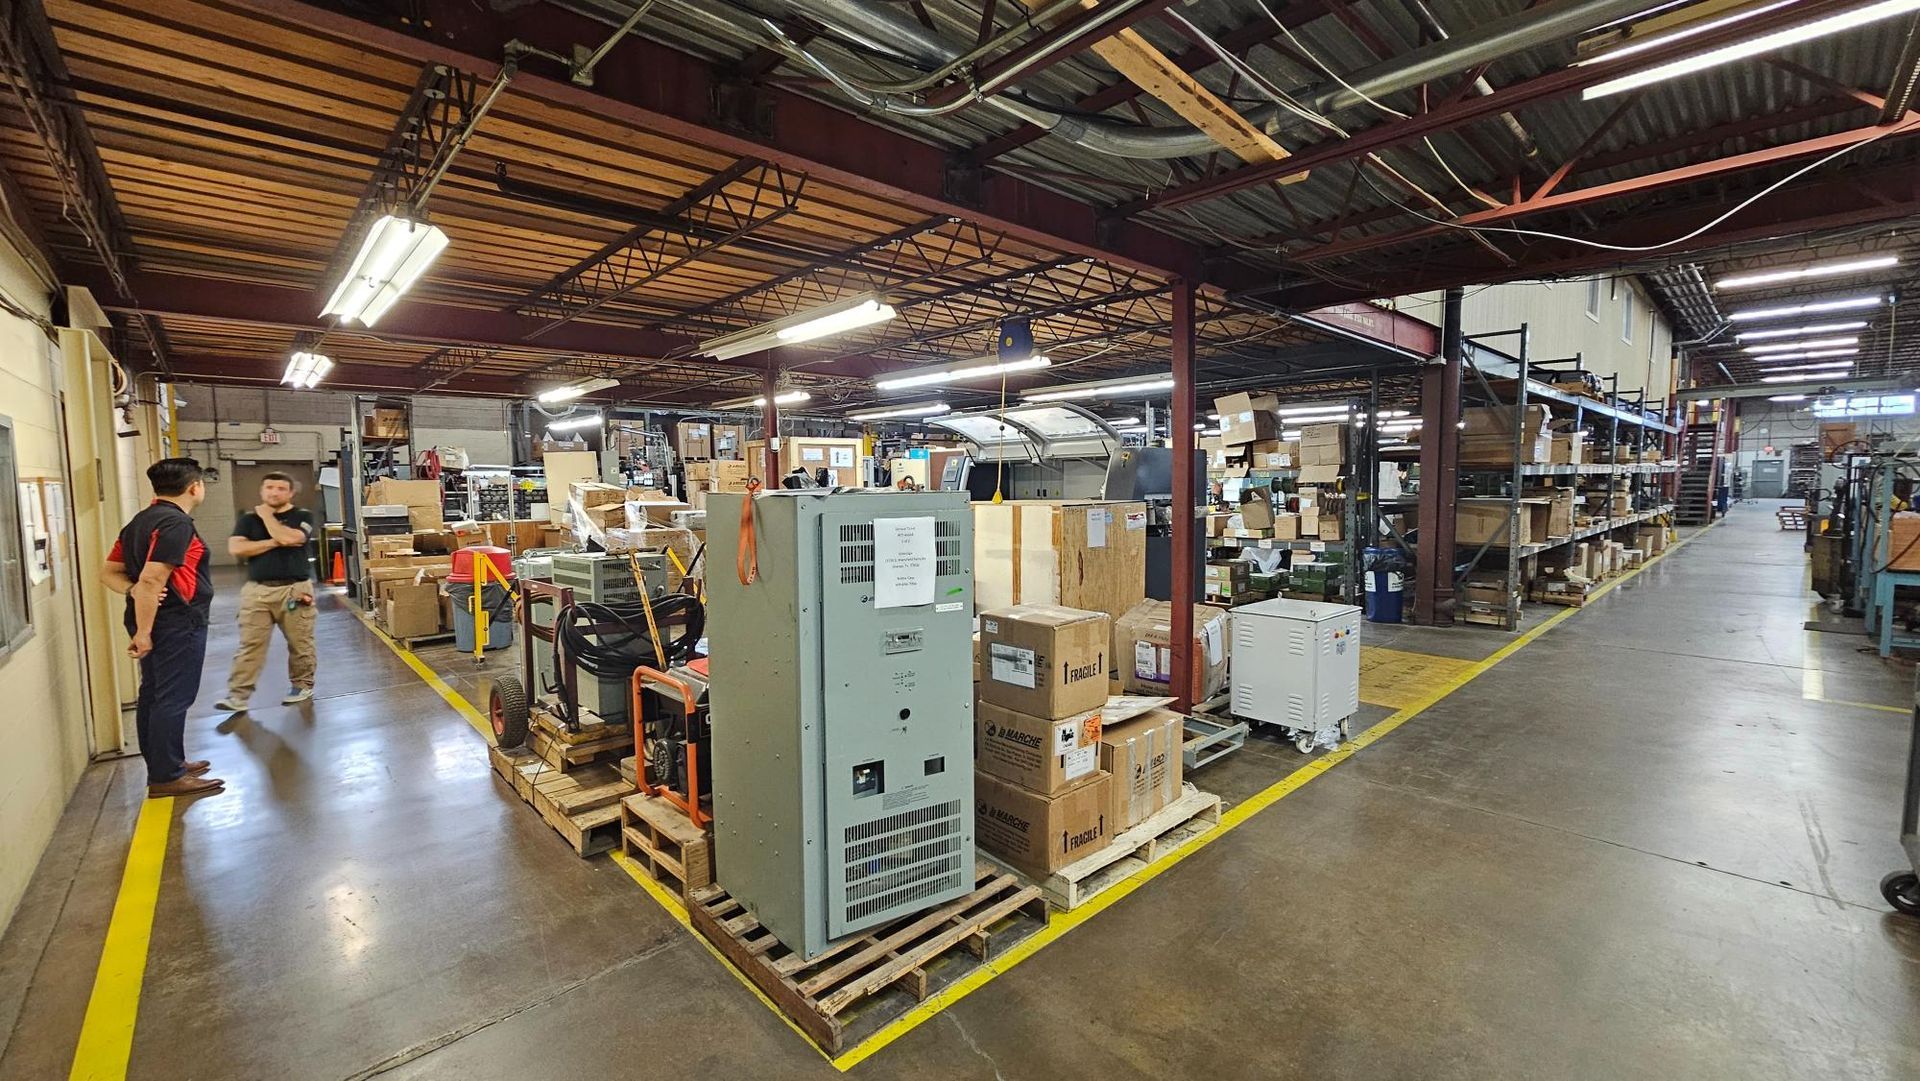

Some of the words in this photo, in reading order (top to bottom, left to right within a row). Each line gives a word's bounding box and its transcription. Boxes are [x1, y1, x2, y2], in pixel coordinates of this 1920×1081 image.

[1070, 662, 1097, 683] FRAGILE
[1005, 728, 1043, 748] MARCHE
[996, 809, 1031, 832] MARCHE
[1070, 826, 1098, 850] FRAGILE
